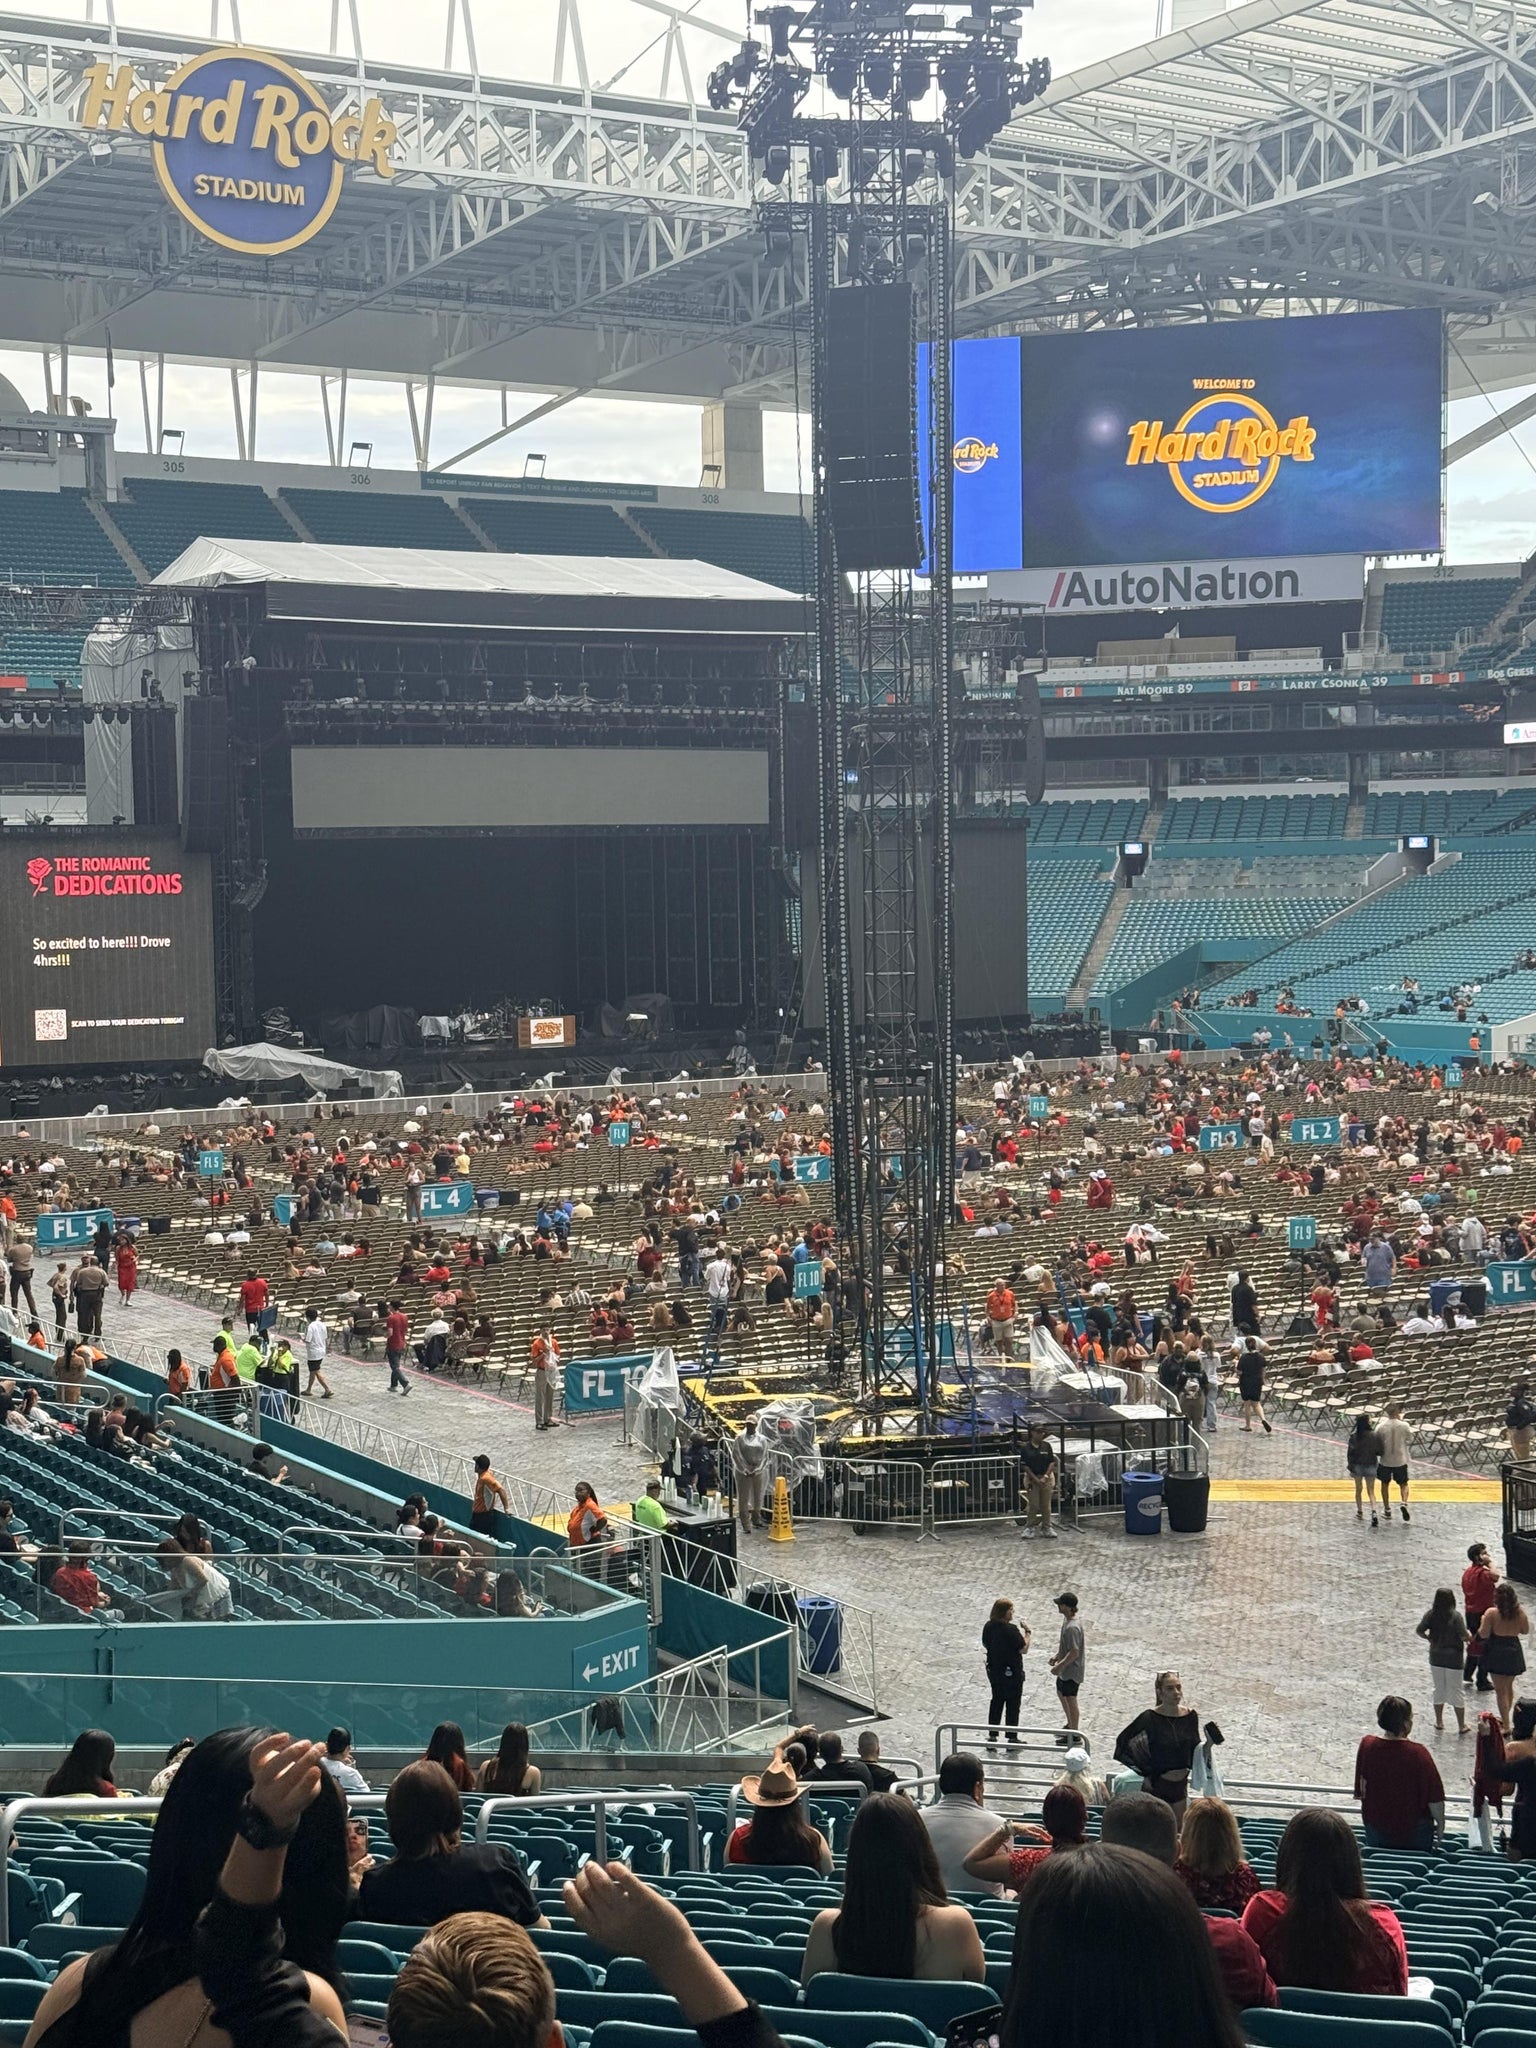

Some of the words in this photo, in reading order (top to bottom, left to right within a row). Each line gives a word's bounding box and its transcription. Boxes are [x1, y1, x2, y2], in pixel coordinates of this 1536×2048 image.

[82, 62, 246, 145] Hard
[251, 84, 397, 178] Rock
[194, 174, 305, 206] STADIUM
[1193, 378, 1240, 390] WELCOME
[1242, 378, 1255, 389] TO
[1126, 418, 1231, 466] Hard
[1228, 415, 1317, 467] Rock
[970, 442, 998, 459] Rock
[163, 461, 185, 473] 305
[350, 473, 371, 485] 306
[1193, 469, 1260, 489] STADIUM
[702, 494, 720, 505] 308
[1433, 567, 1454, 578] 312
[1062, 564, 1299, 608] AutoNation
[1177, 683, 1193, 694] 89
[1372, 676, 1388, 687] 39
[54, 857, 80, 872] THE
[82, 856, 151, 872] ROMANTIC
[54, 873, 183, 896] DEDICATIONS
[33, 937, 47, 950] So
[49, 936, 86, 950] excited
[88, 937, 100, 949] to
[102, 936, 138, 949] here!!!
[141, 936, 171, 948] Drove
[33, 954, 70, 967] 4hrs!!!
[613, 1128, 620, 1139] FL
[621, 1128, 626, 1139] 4
[1210, 1131, 1223, 1148] FL
[1302, 1123, 1319, 1140] FL
[1323, 1122, 1332, 1139] 2
[204, 1156, 214, 1168] FL
[214, 1155, 219, 1168] 5
[806, 1161, 819, 1180] 4
[421, 1190, 442, 1210] FL
[447, 1188, 461, 1208] 4
[53, 1217, 79, 1239] FL
[85, 1214, 98, 1236] 5
[1294, 1225, 1304, 1240] FL
[1306, 1225, 1312, 1240] 9
[798, 1274, 808, 1288] FL
[809, 1270, 820, 1287] 10
[1502, 1269, 1526, 1294] FL
[582, 1369, 614, 1399] FL
[602, 1645, 640, 1679] EXIT
